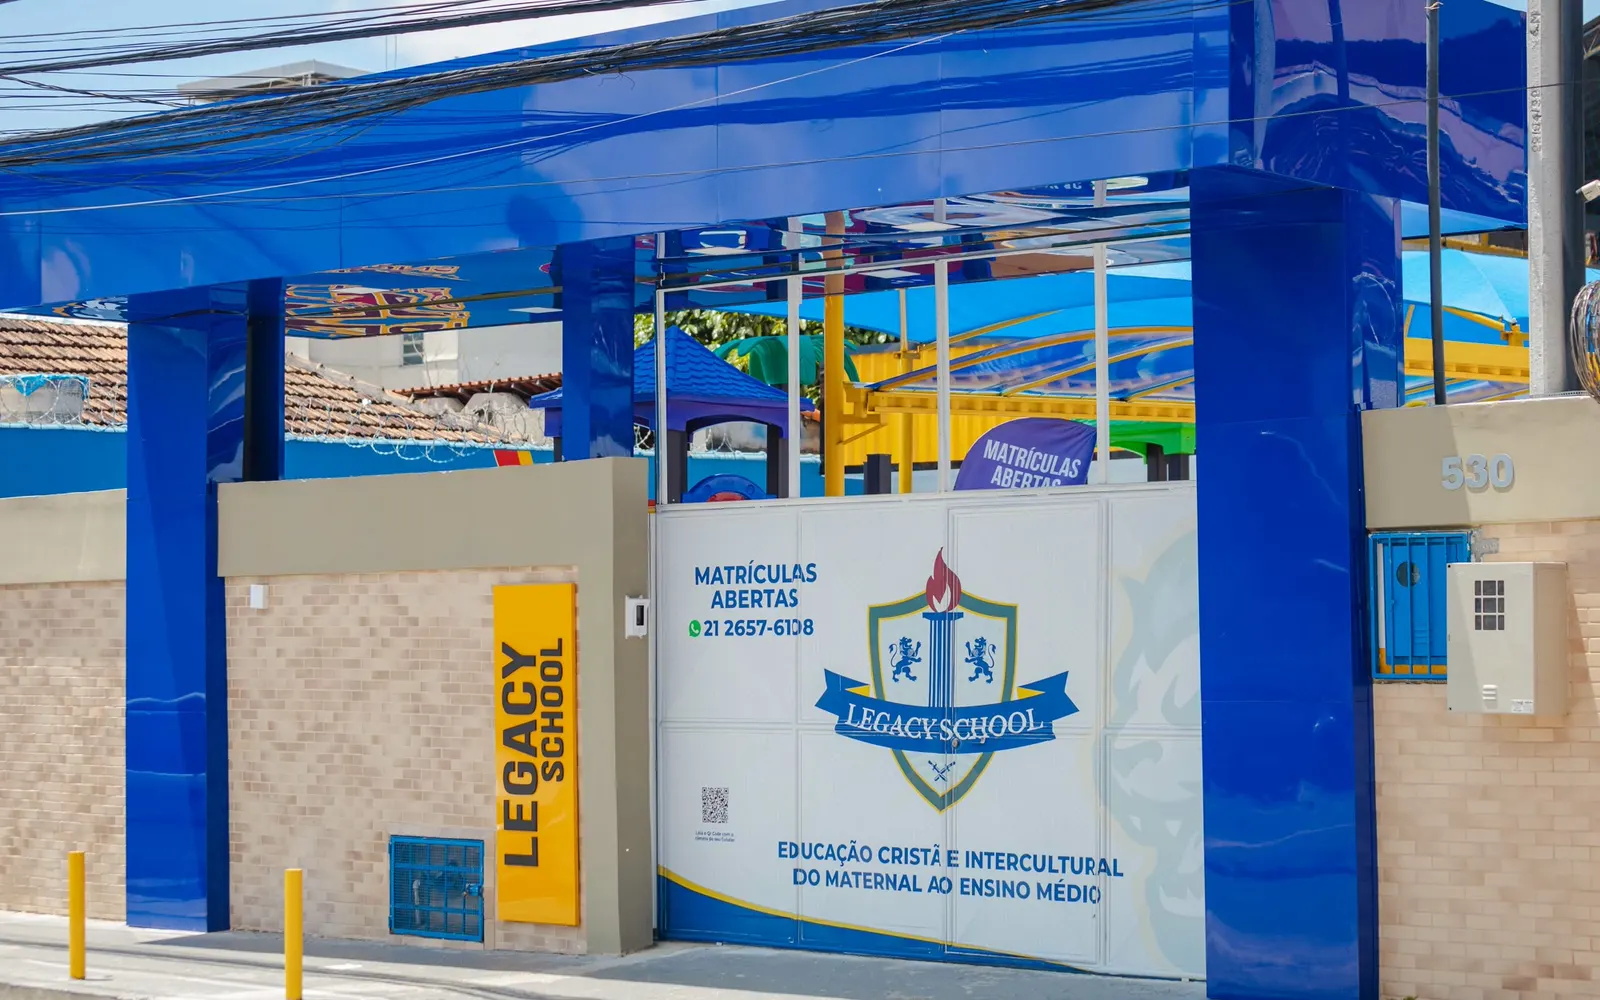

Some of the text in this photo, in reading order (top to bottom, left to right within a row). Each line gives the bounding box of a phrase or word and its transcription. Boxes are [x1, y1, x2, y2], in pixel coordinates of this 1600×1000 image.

[983, 439, 1081, 478] MATRÍCULAS
[1441, 454, 1515, 490] 530
[695, 560, 818, 586] MATRÍCULAS
[711, 588, 799, 609] ABERTAS
[704, 620, 719, 637] 21
[540, 638, 565, 782] SCHOOL
[844, 703, 1044, 741] LEGACY SCHOOL
[501, 641, 539, 867] LEGACY
[778, 840, 1124, 877] EDUCAÇÃO CRISTÃ E INTERCULTURAL
[793, 868, 1102, 905] DO MATERNAL AO ENSINO MÉDIO
